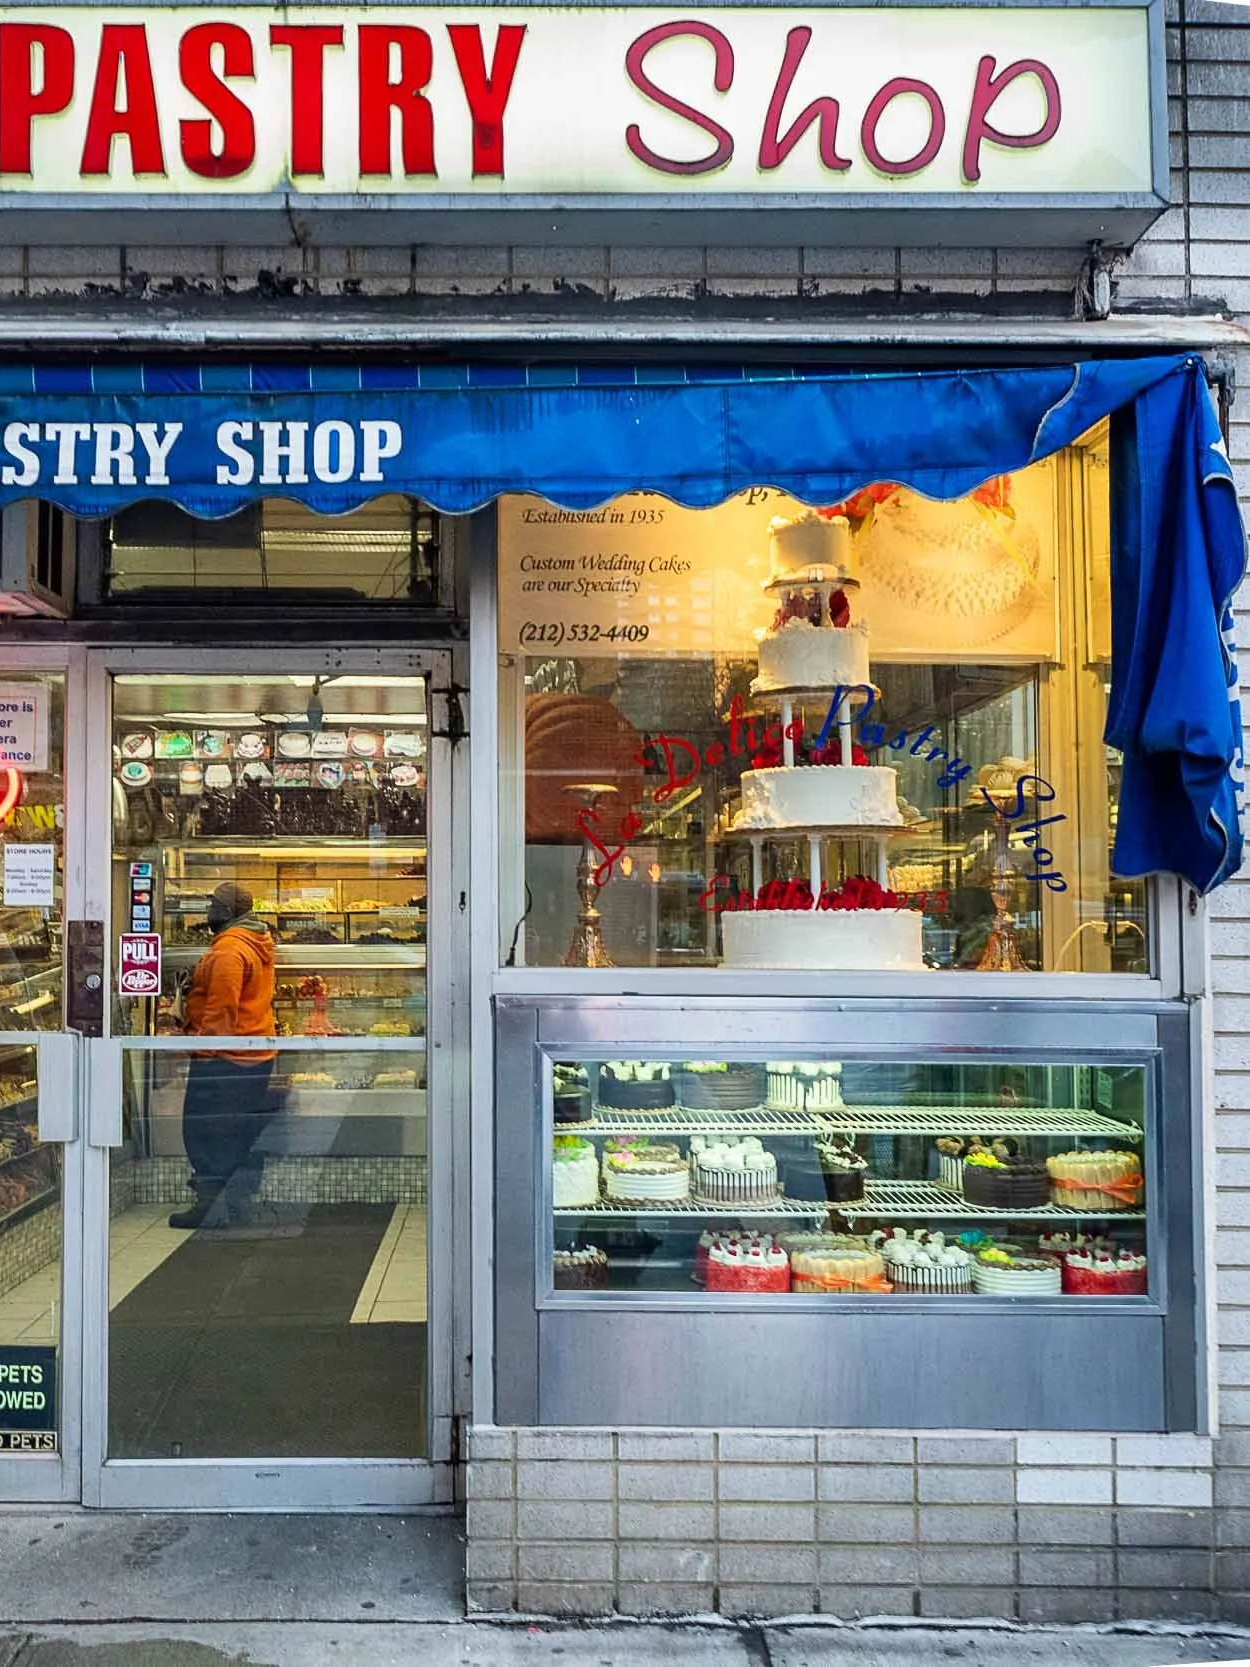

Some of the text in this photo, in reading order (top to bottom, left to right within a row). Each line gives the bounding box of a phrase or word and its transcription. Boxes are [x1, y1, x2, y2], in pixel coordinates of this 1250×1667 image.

[625, 19, 1062, 184] Shop
[216, 420, 402, 485] SHOP
[610, 509, 623, 524] in
[629, 509, 665, 524] 1935
[520, 553, 692, 575] Custom Wedding Cakes
[522, 576, 640, 597] are our Specialty
[519, 621, 649, 646] (212) 532-4409
[576, 684, 1068, 893] La Delice Pastry Shop
[122, 942, 158, 960] PULL
[10, 1434, 54, 1449] PETS
